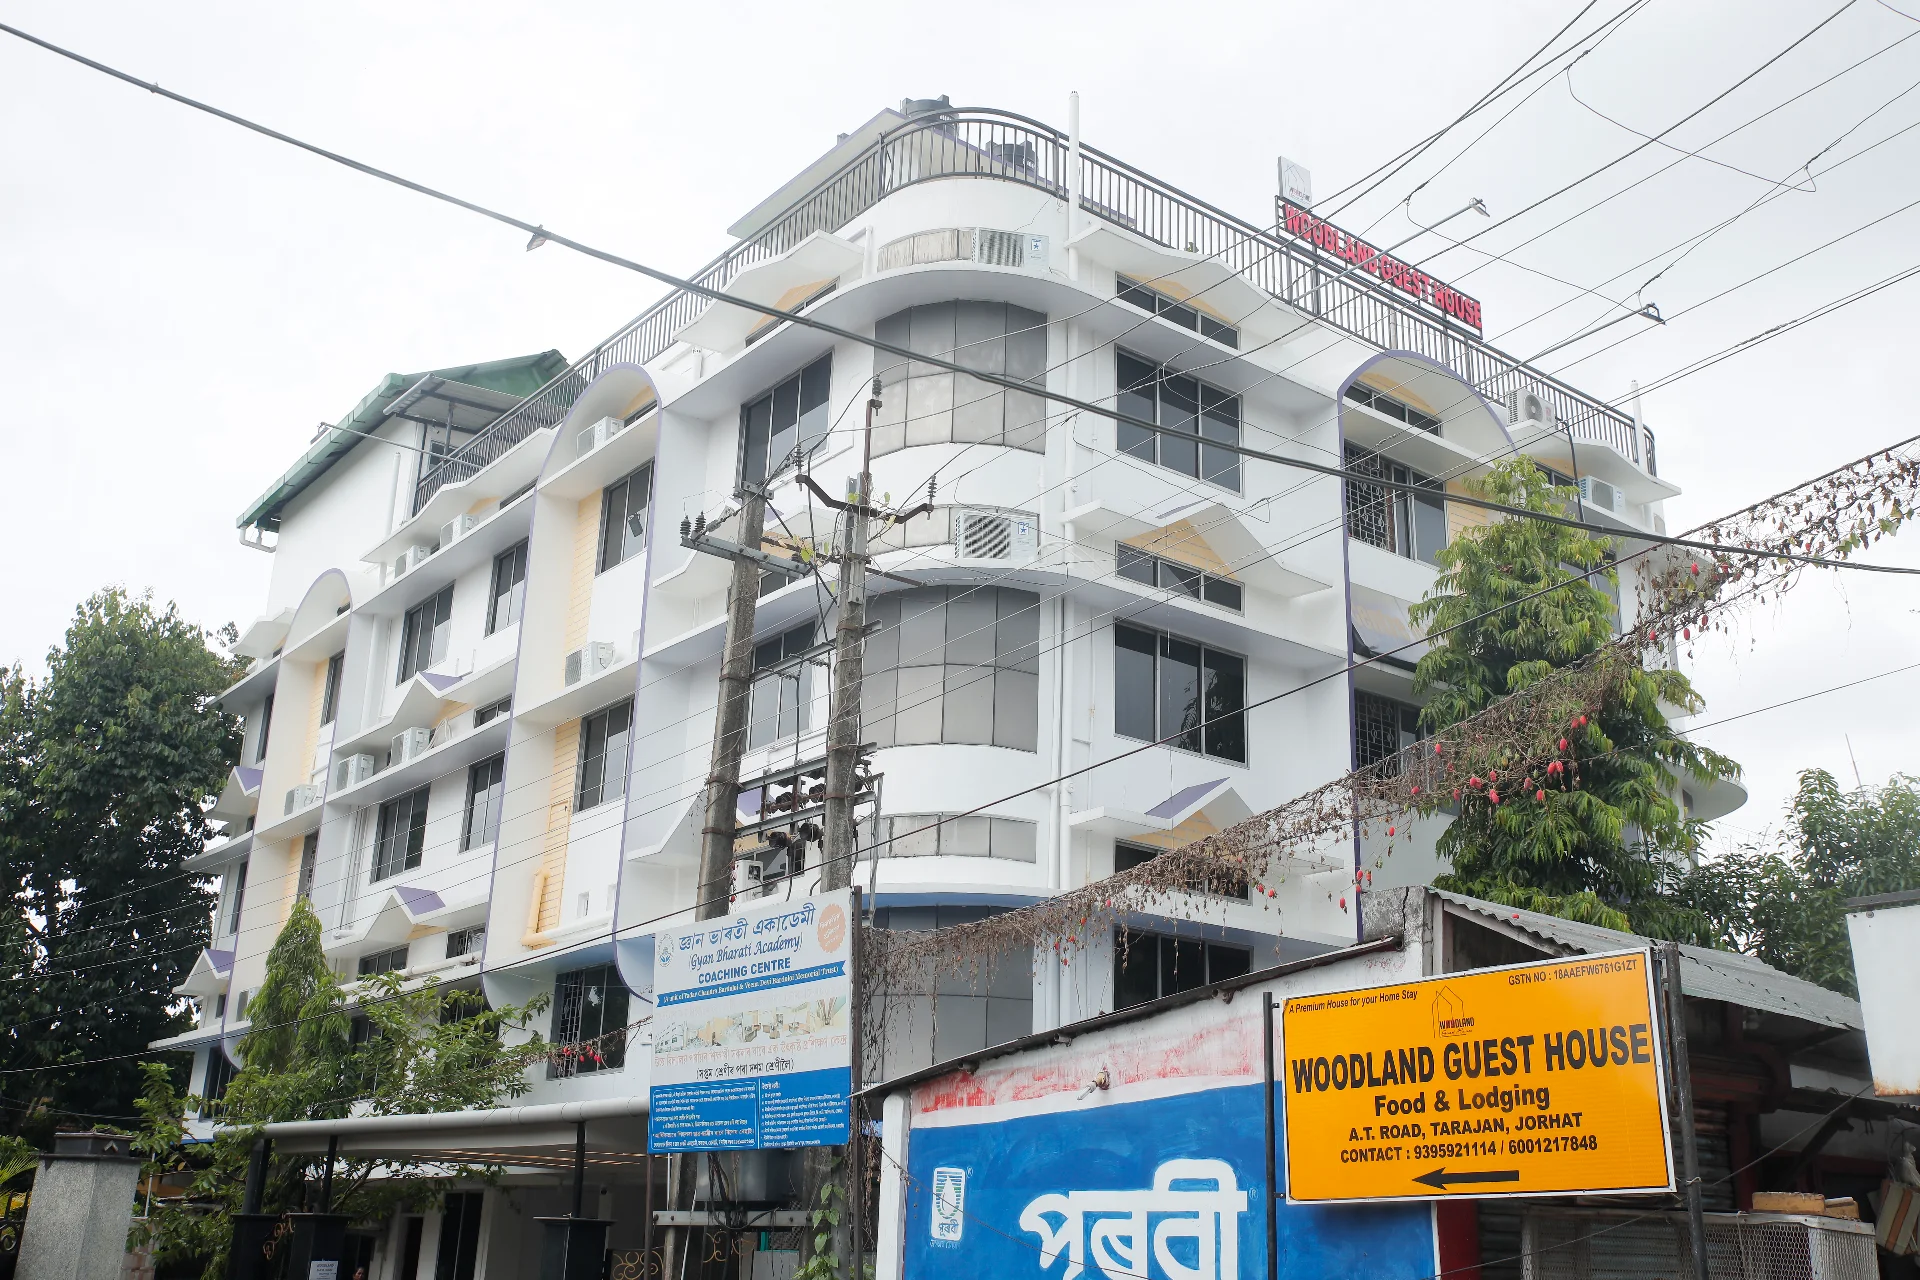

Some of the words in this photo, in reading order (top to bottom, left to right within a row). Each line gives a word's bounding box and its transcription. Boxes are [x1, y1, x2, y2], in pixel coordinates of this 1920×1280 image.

[1284, 203, 1378, 274] WOODLAND
[1380, 254, 1431, 300] GUEST
[1433, 281, 1483, 329] HOUSE
[679, 932, 705, 951] জ্ঞান
[709, 917, 749, 945] ভাৰতী
[753, 902, 816, 935] একাডেমী
[716, 942, 752, 963] Bharati
[698, 965, 748, 985] COACHING
[750, 957, 791, 975] CENTRE
[795, 969, 821, 980] Memorial
[1508, 972, 1531, 986] GSTN
[1533, 971, 1546, 983] NO
[1553, 959, 1637, 980] 18AAEFW6761G1ZT
[1289, 1004, 1294, 1014] A
[1296, 1001, 1325, 1013] Premium
[1327, 998, 1348, 1009] House
[1350, 996, 1360, 1007] for
[1361, 995, 1378, 1008] your
[1379, 991, 1400, 1003] Home
[1402, 989, 1418, 1000] Stay
[1291, 1045, 1435, 1094] WOODLAND
[1443, 1035, 1535, 1081] GUEST
[1543, 1023, 1651, 1072] HOUSE
[1374, 1092, 1426, 1117] Food
[1433, 1089, 1451, 1113] &
[1458, 1083, 1551, 1114] Lodging
[1348, 1126, 1376, 1142] A.T.
[1379, 1123, 1426, 1140] ROAD,
[1429, 1116, 1510, 1136] TARAJAN,
[1514, 1112, 1583, 1132] JORHAT
[1340, 1145, 1403, 1164] CONTACT
[1413, 1140, 1497, 1160] 9395921114
[1507, 1134, 1598, 1155] 6001217848
